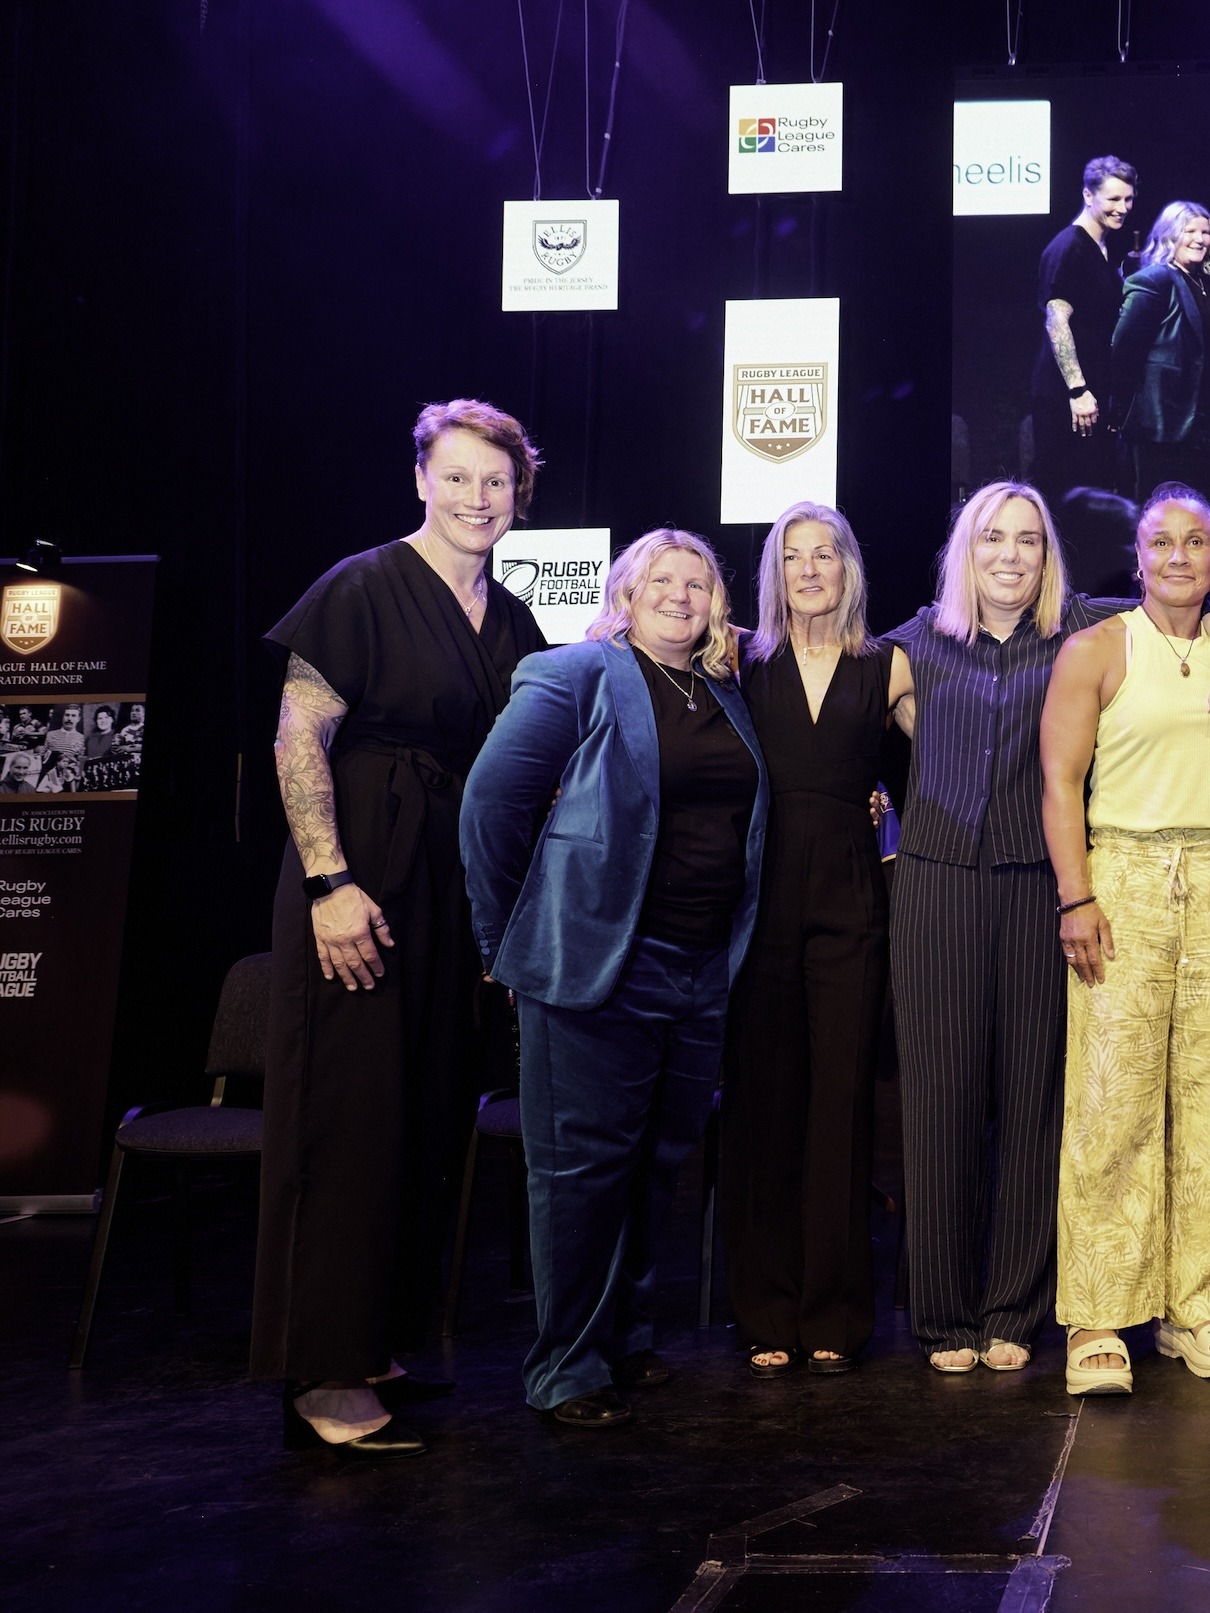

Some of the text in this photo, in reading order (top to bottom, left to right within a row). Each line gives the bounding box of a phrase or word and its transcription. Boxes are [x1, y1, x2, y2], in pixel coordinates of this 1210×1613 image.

[778, 117, 828, 129] Rugby
[778, 131, 835, 143] League
[777, 143, 825, 153] Cares
[543, 225, 577, 238] ELLIS
[541, 251, 577, 267] RUGBY
[741, 369, 820, 378] RUGBY LEAGUE
[750, 388, 810, 404] HALL
[773, 407, 786, 415] OF
[749, 418, 810, 434] FAME
[541, 560, 603, 577] RUGBY
[540, 579, 601, 590] FOOTBALL
[538, 591, 600, 606] LEAGUE
[12, 603, 48, 613] HALL
[10, 623, 47, 634] FAME
[30, 662, 59, 671] HALL
[60, 661, 76, 671] OF
[77, 661, 107, 670] FAME
[41, 674, 83, 684] DINNER
[29, 817, 85, 831] RUGBY
[0, 880, 46, 893] Rugby
[0, 907, 40, 918] Cares
